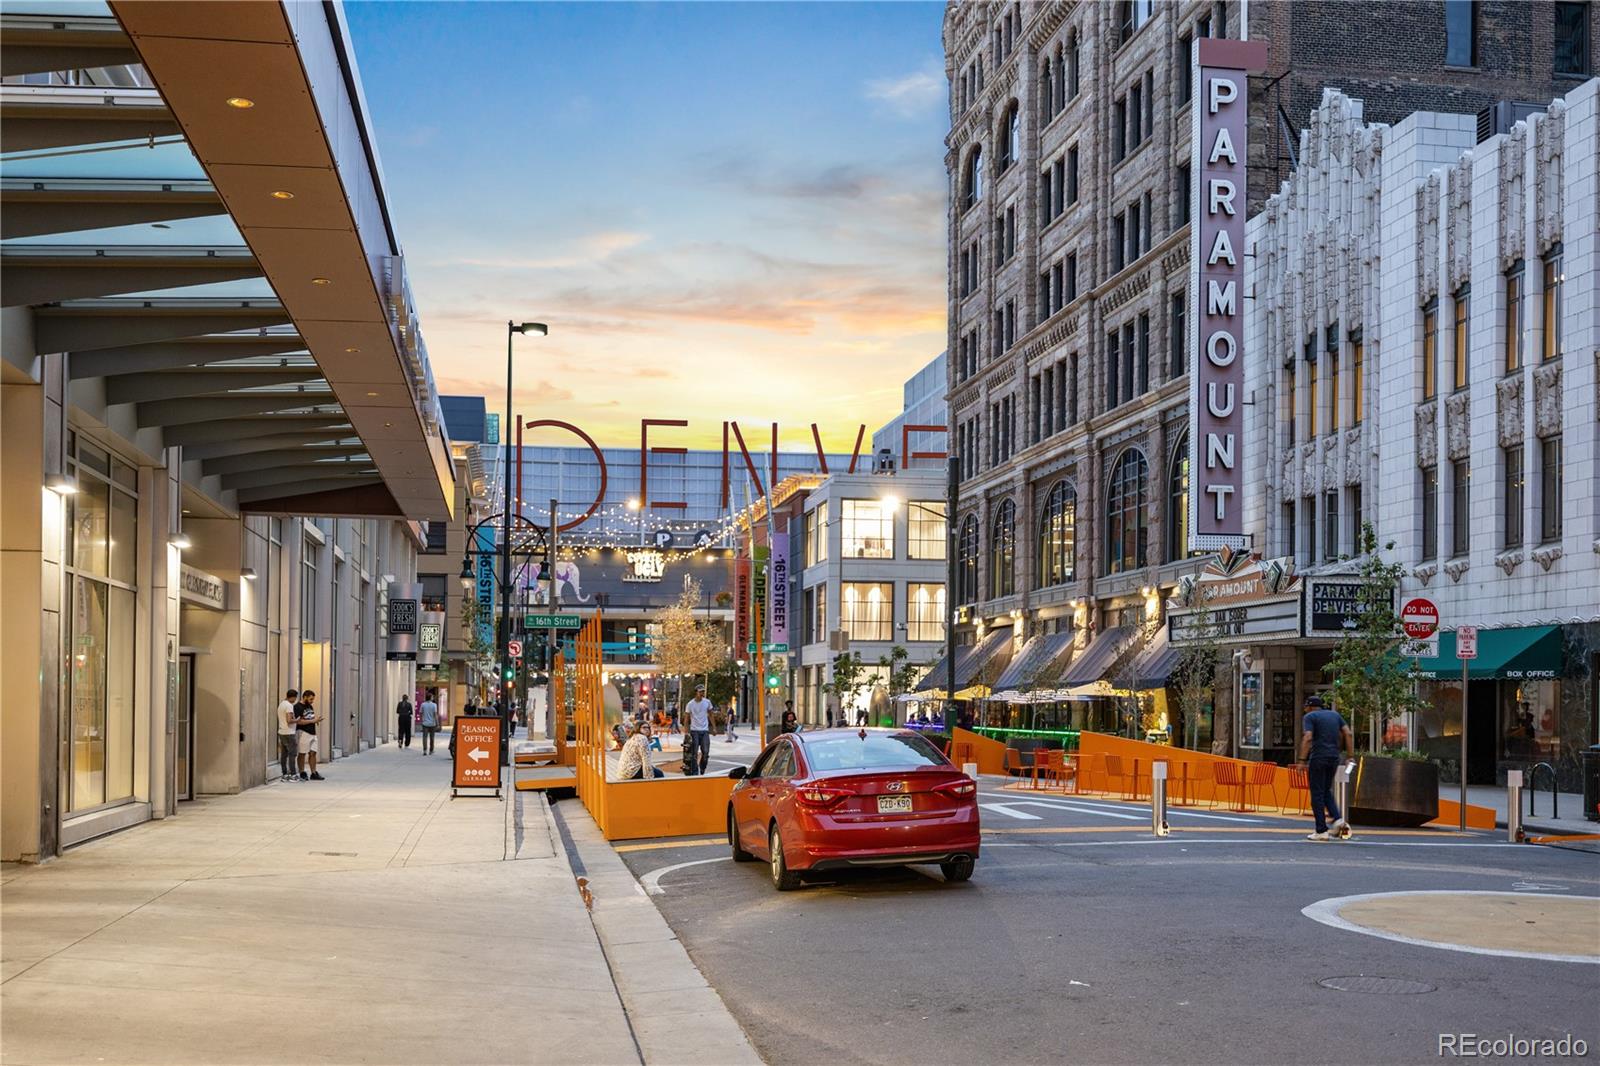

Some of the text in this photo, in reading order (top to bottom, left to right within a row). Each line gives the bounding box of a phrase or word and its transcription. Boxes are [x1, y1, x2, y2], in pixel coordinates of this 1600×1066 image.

[1206, 76, 1238, 521] PARAMOUNT
[774, 584, 786, 629] STREET
[393, 613, 414, 623] FRESH
[535, 616, 552, 626] 16th
[554, 616, 578, 626] Street
[1506, 670, 1555, 678] BOX OFFICE
[464, 735, 494, 743] OFFICE
